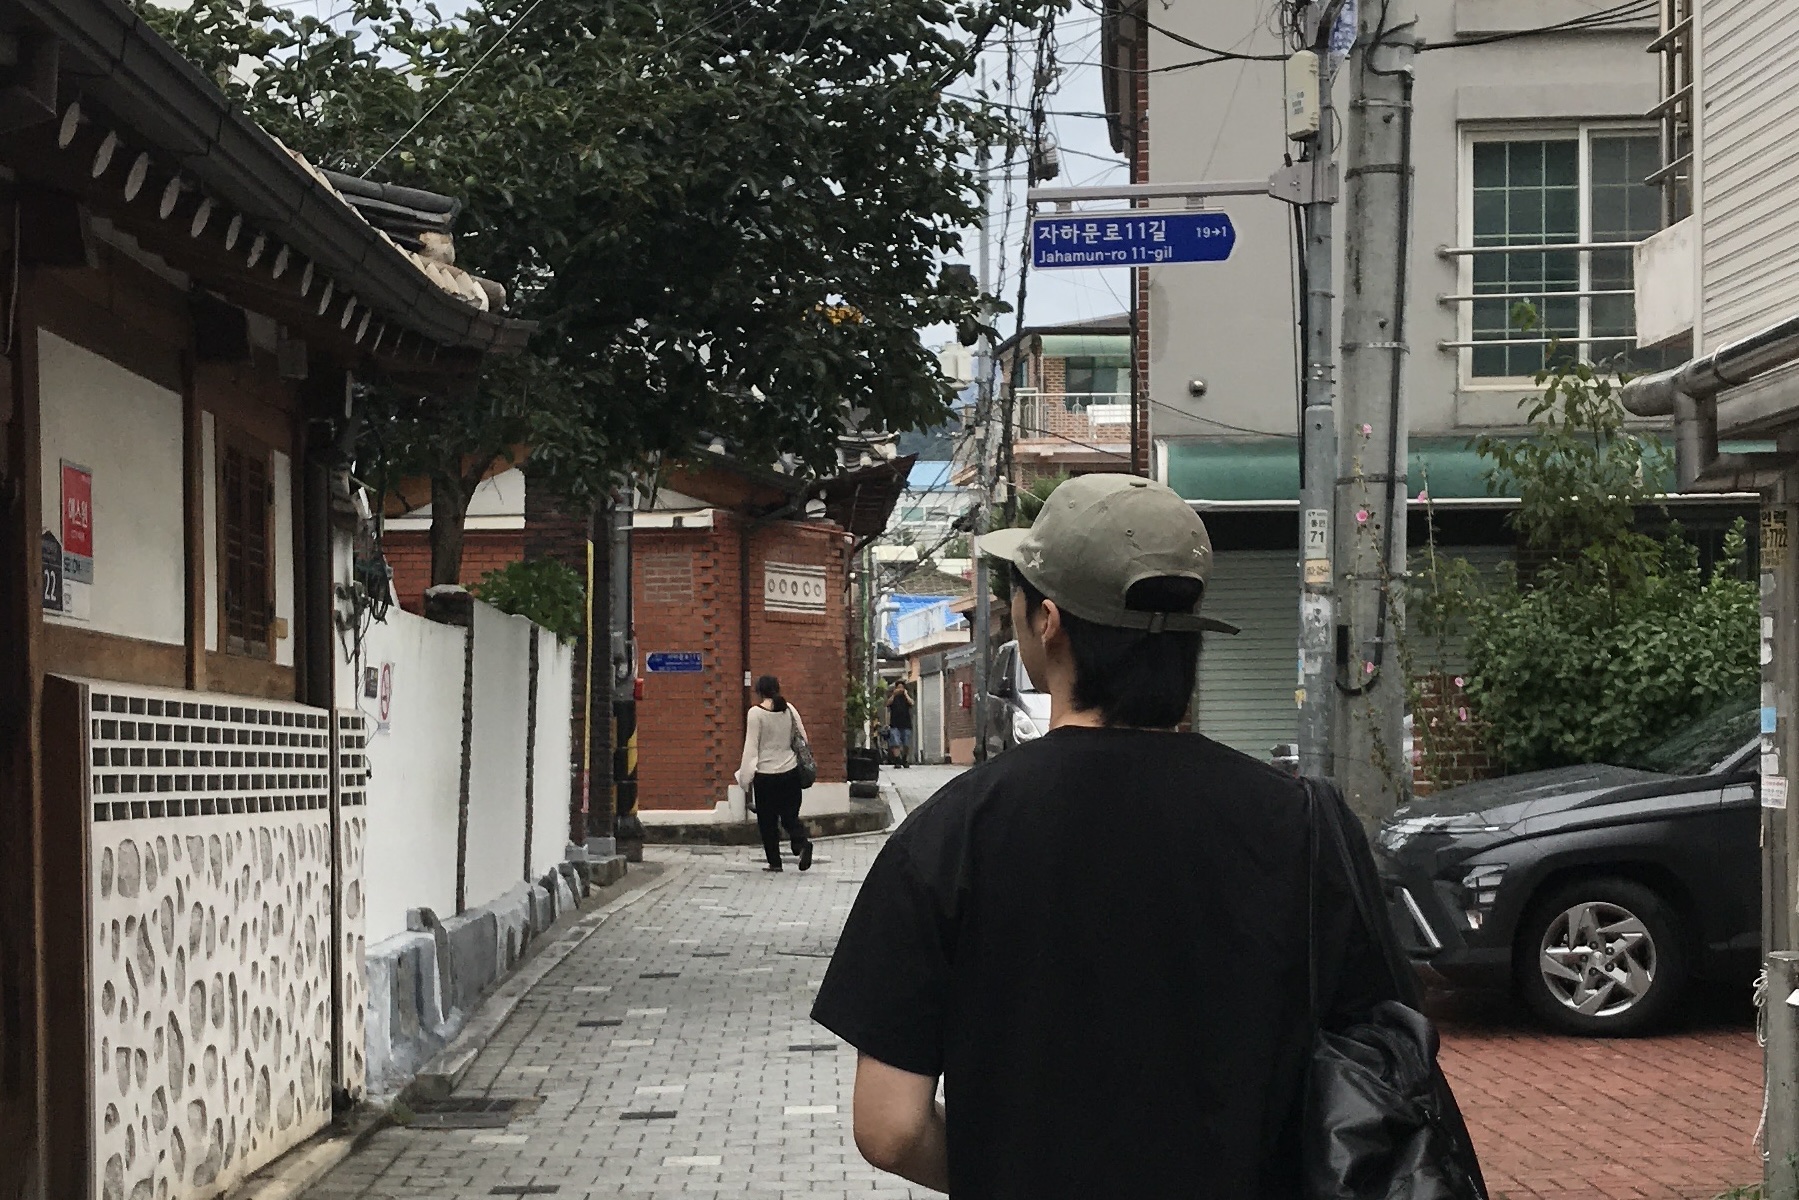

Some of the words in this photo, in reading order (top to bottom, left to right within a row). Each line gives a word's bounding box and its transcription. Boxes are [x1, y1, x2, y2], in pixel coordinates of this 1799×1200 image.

[1038, 220, 1166, 245] 자하문로11길
[1038, 250, 1127, 264] Jahamun-ro
[1131, 246, 1173, 261] 11-gil
[1310, 530, 1325, 543] 71
[44, 569, 57, 601] 22
